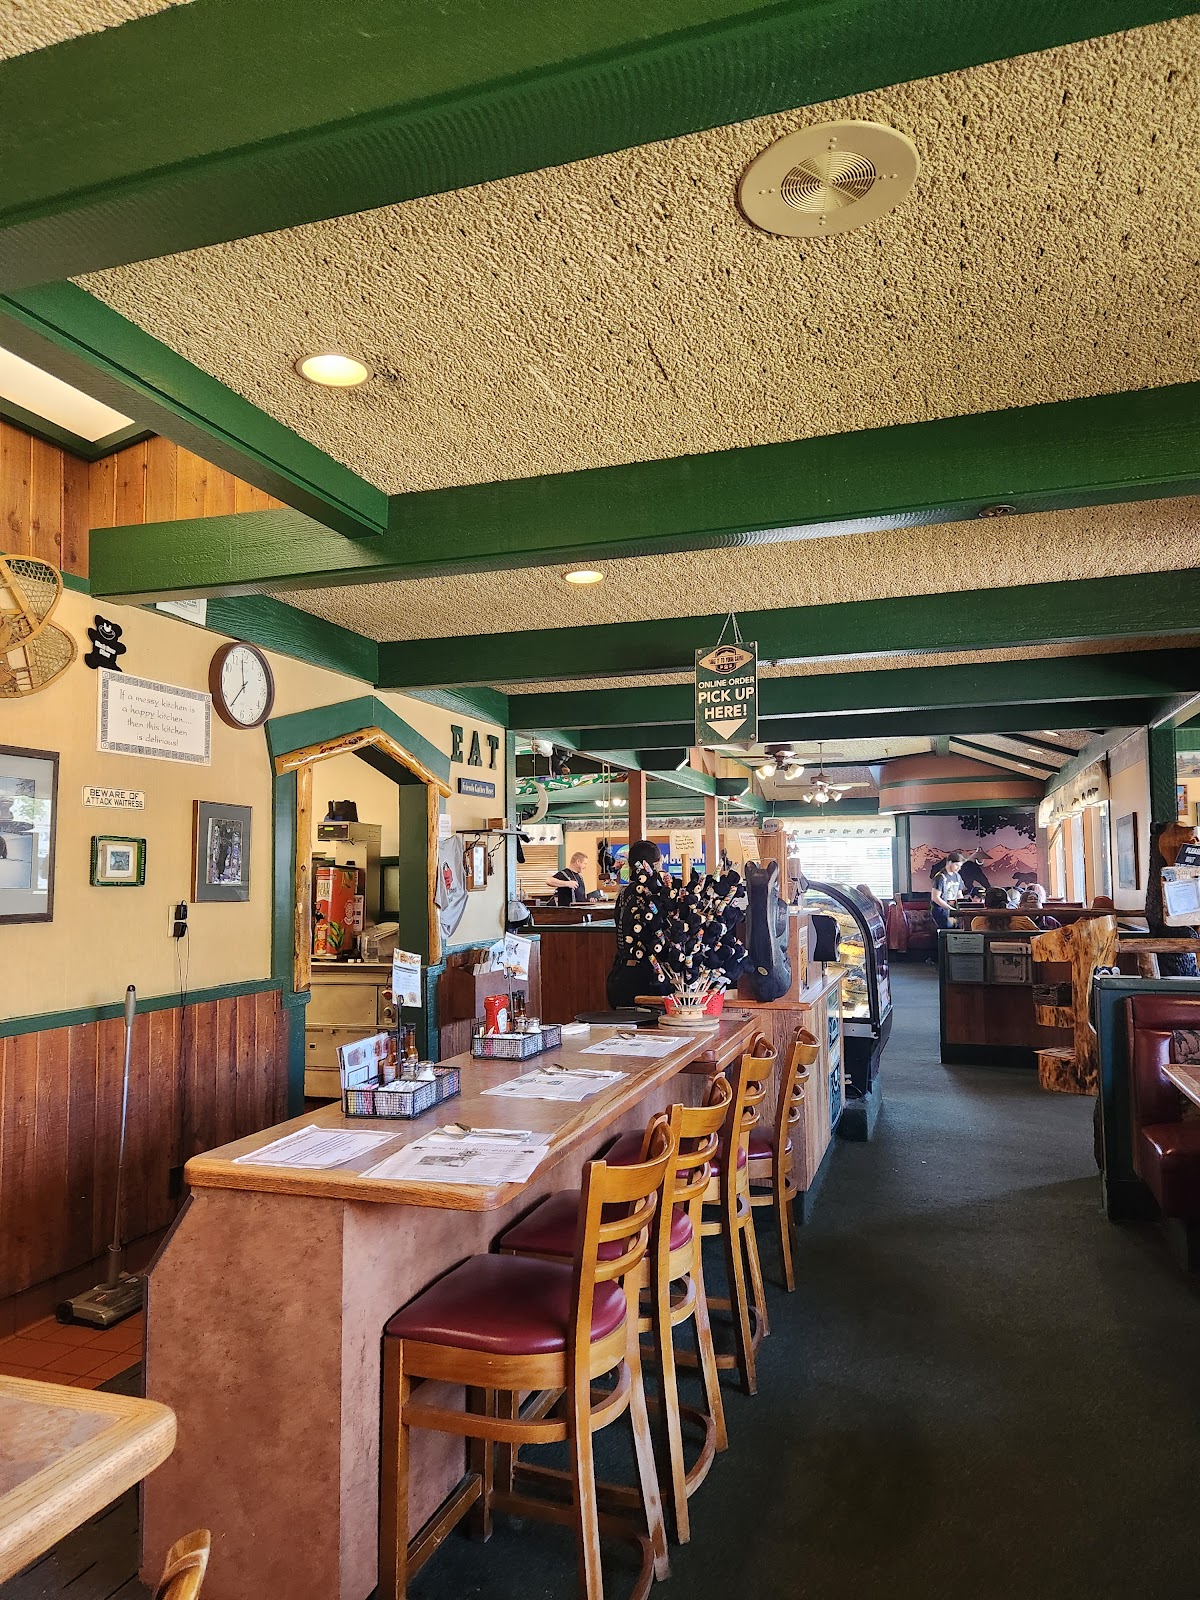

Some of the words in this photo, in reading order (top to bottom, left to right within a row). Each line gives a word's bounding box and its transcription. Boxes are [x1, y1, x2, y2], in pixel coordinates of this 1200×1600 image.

[698, 679, 727, 689] ONLINE
[728, 676, 755, 686] ORDER
[119, 689, 126, 701] If
[135, 695, 160, 708] messy
[161, 698, 187, 712] kitchen
[189, 705, 196, 714] is
[698, 689, 732, 705] PICK
[735, 687, 755, 701] UP
[121, 705, 128, 713] a
[130, 705, 155, 720] happy
[704, 704, 747, 719] HERE!
[127, 717, 144, 728] then
[146, 721, 160, 731] this
[161, 723, 188, 736] kitchen
[136, 732, 143, 741] is
[145, 733, 179, 747] delirious!
[450, 724, 499, 770] EAT
[89, 788, 126, 799] BEWARE
[129, 792, 140, 800] OF
[85, 796, 113, 806] ATTACK
[113, 798, 143, 808] WAITRESS
